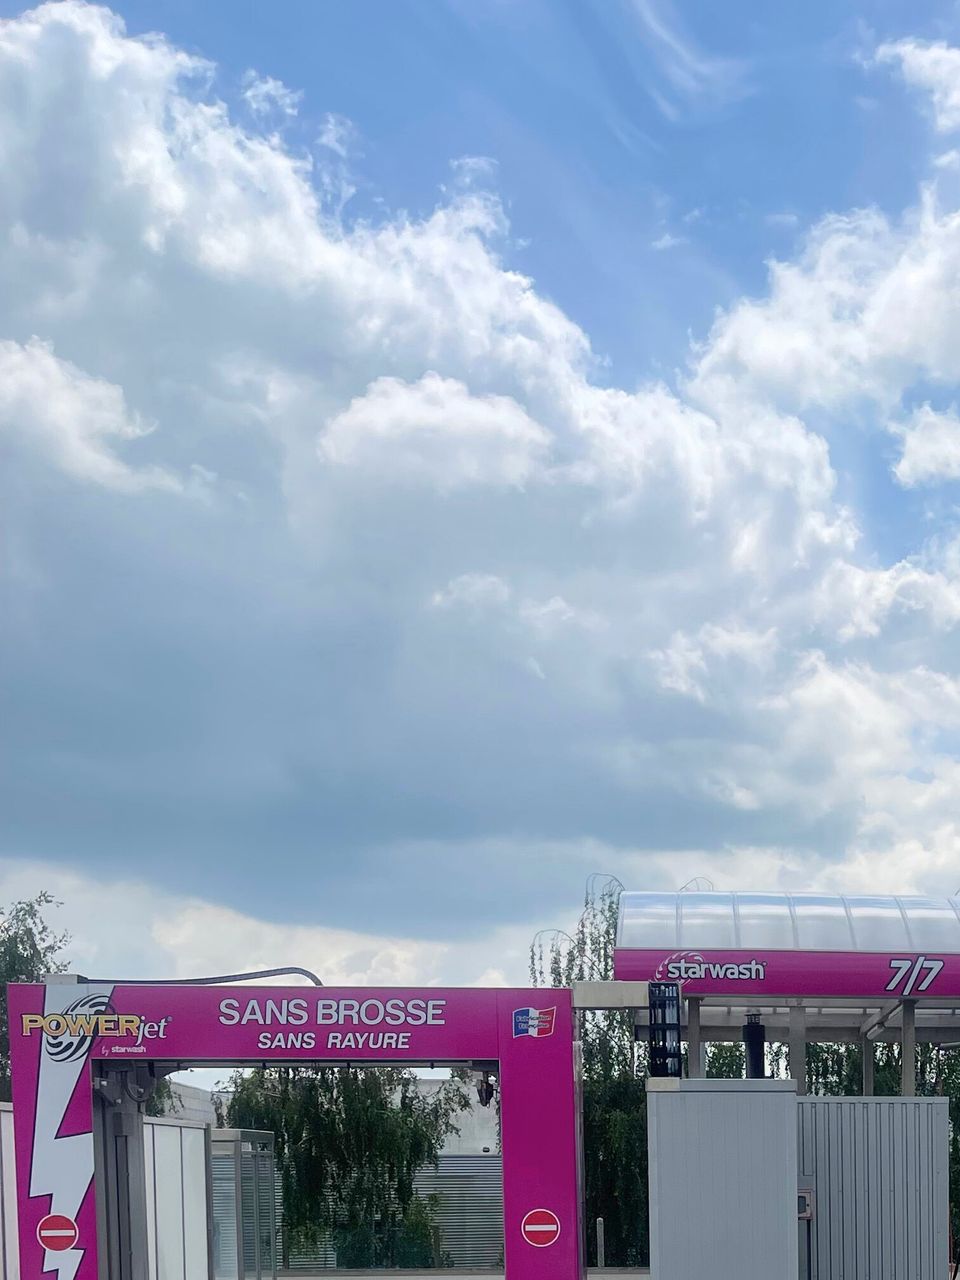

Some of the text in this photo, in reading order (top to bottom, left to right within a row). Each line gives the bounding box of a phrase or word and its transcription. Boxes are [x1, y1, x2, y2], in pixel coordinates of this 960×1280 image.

[667, 959, 765, 980] starwash
[885, 956, 944, 996] 7/7
[218, 998, 447, 1025] SANS BROSSE
[257, 1032, 412, 1049] SANS RAYURE
